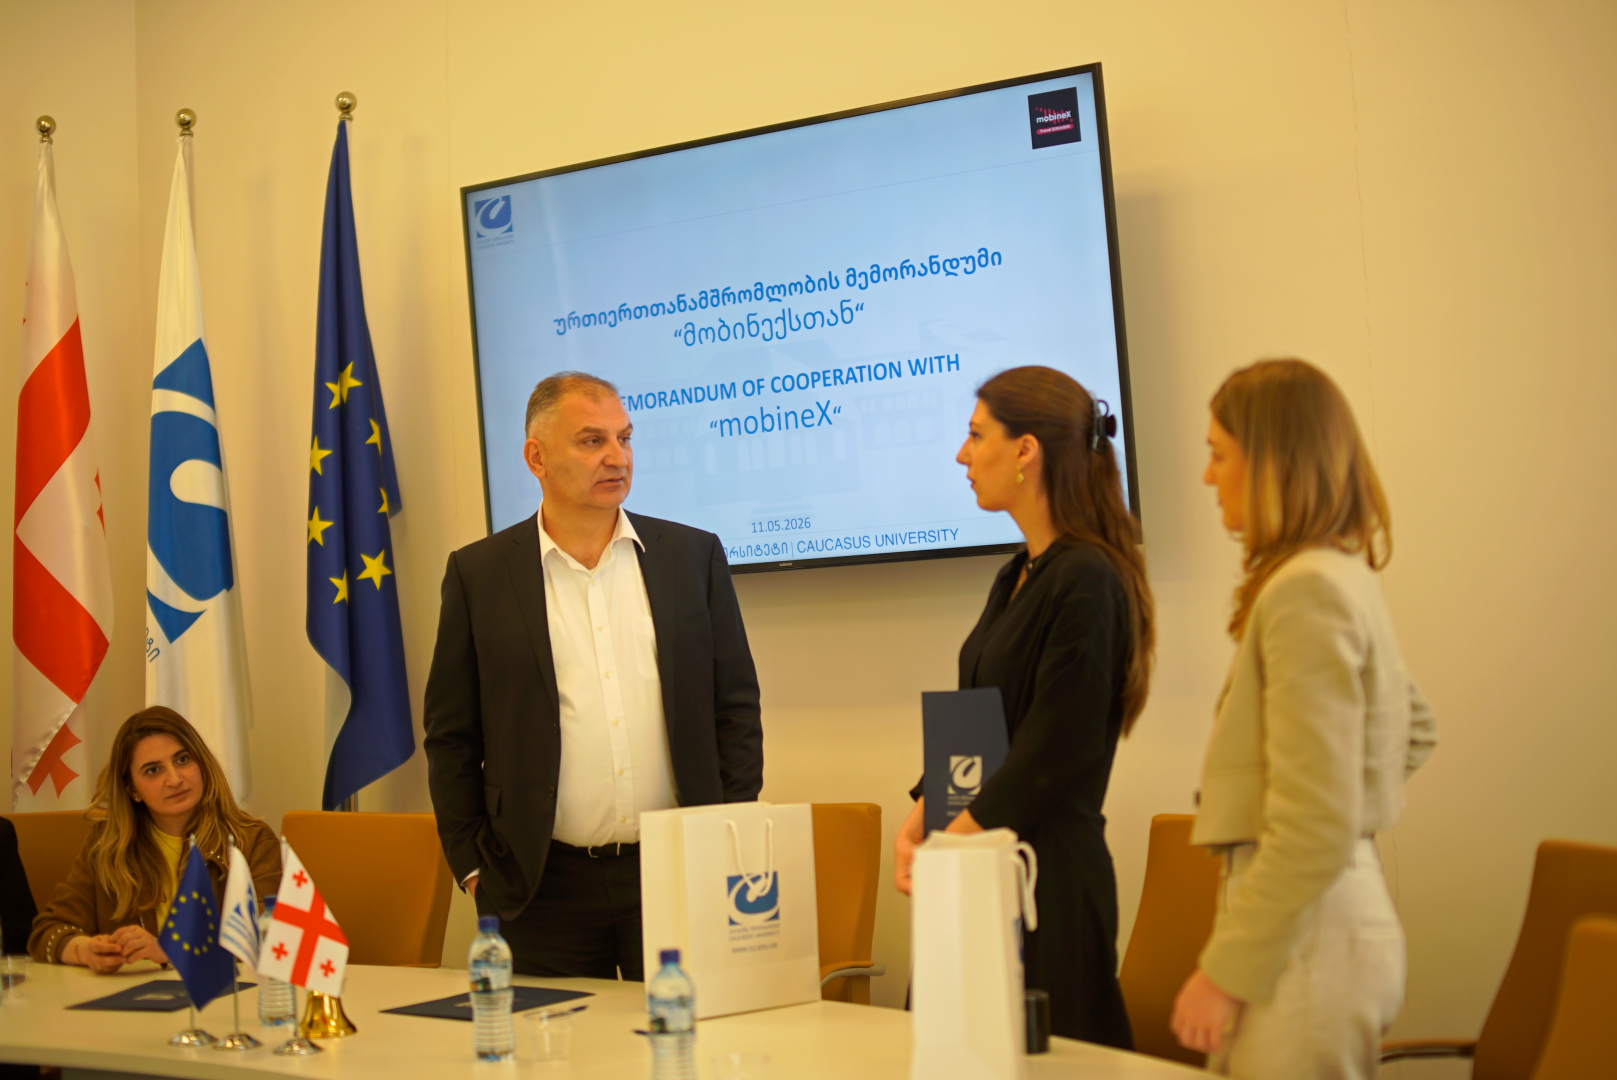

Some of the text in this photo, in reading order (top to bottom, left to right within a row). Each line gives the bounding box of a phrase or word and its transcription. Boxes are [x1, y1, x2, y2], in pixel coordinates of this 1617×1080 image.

[1036, 110, 1072, 123] mobineX
[553, 247, 1002, 336] ურთიერთთანამშრომლობის მემორანდუმი
[742, 377, 765, 397] OF
[770, 360, 902, 394] COOPERATION
[907, 353, 960, 377] WITH
[751, 517, 812, 534] 11.05.2026
[797, 527, 959, 554] CAUCASUS UNIVERSITY
